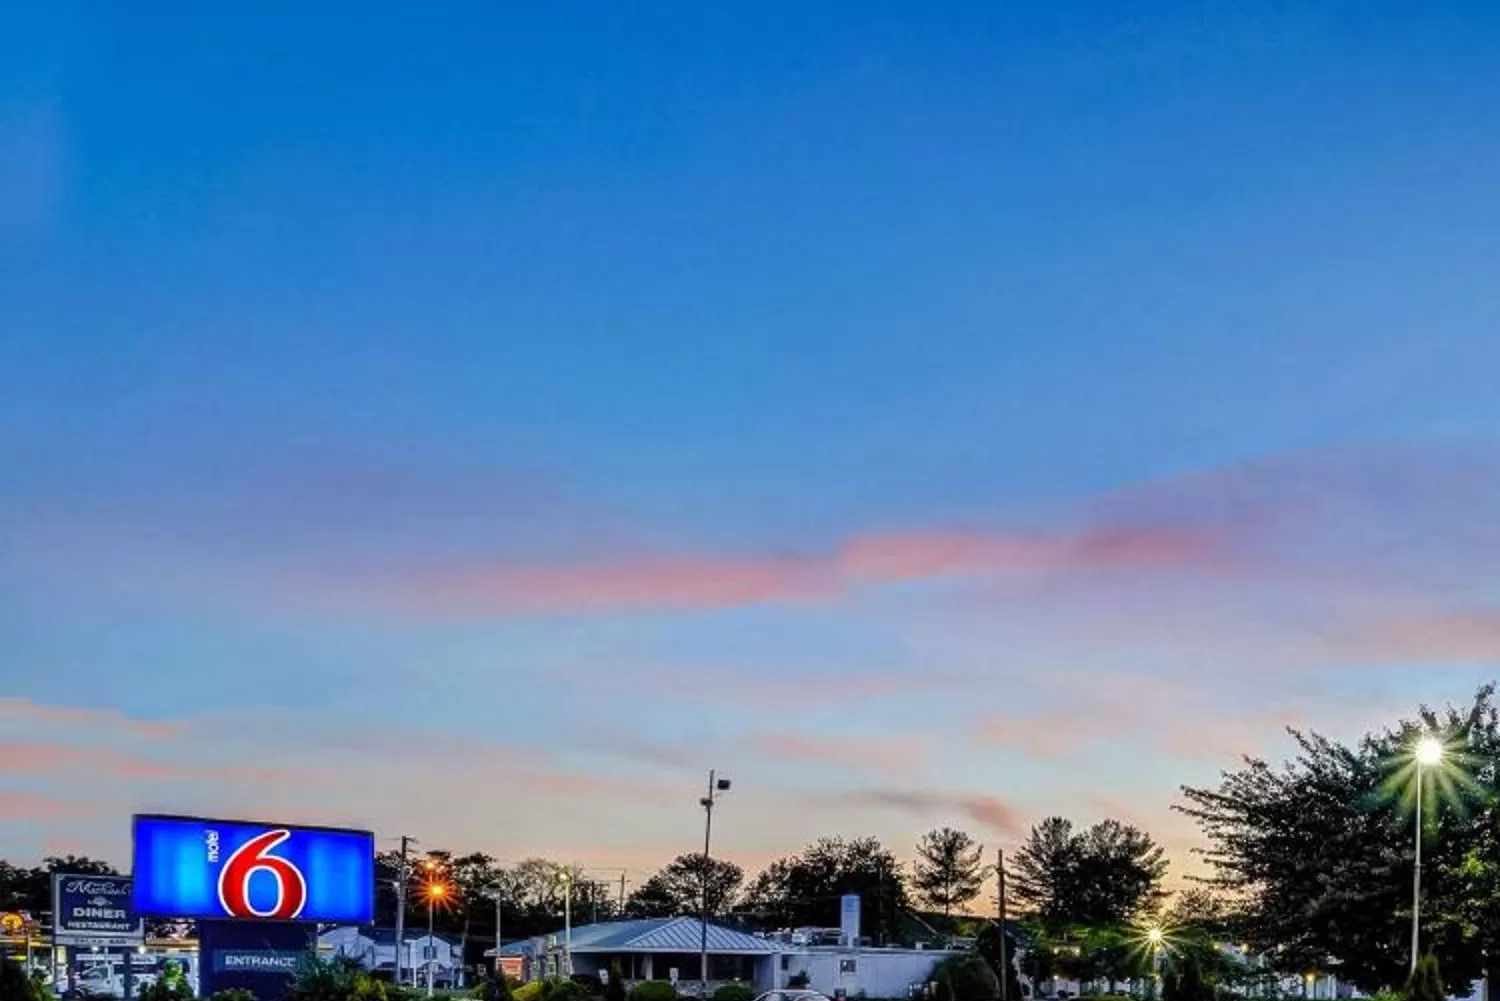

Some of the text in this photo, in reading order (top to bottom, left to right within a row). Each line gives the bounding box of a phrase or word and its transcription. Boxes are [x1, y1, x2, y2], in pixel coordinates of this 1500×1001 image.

[204, 828, 307, 919] motel 6
[73, 907, 126, 919] DINER
[67, 920, 130, 930] RESTAURANT
[225, 955, 297, 967] ENTRANCE
